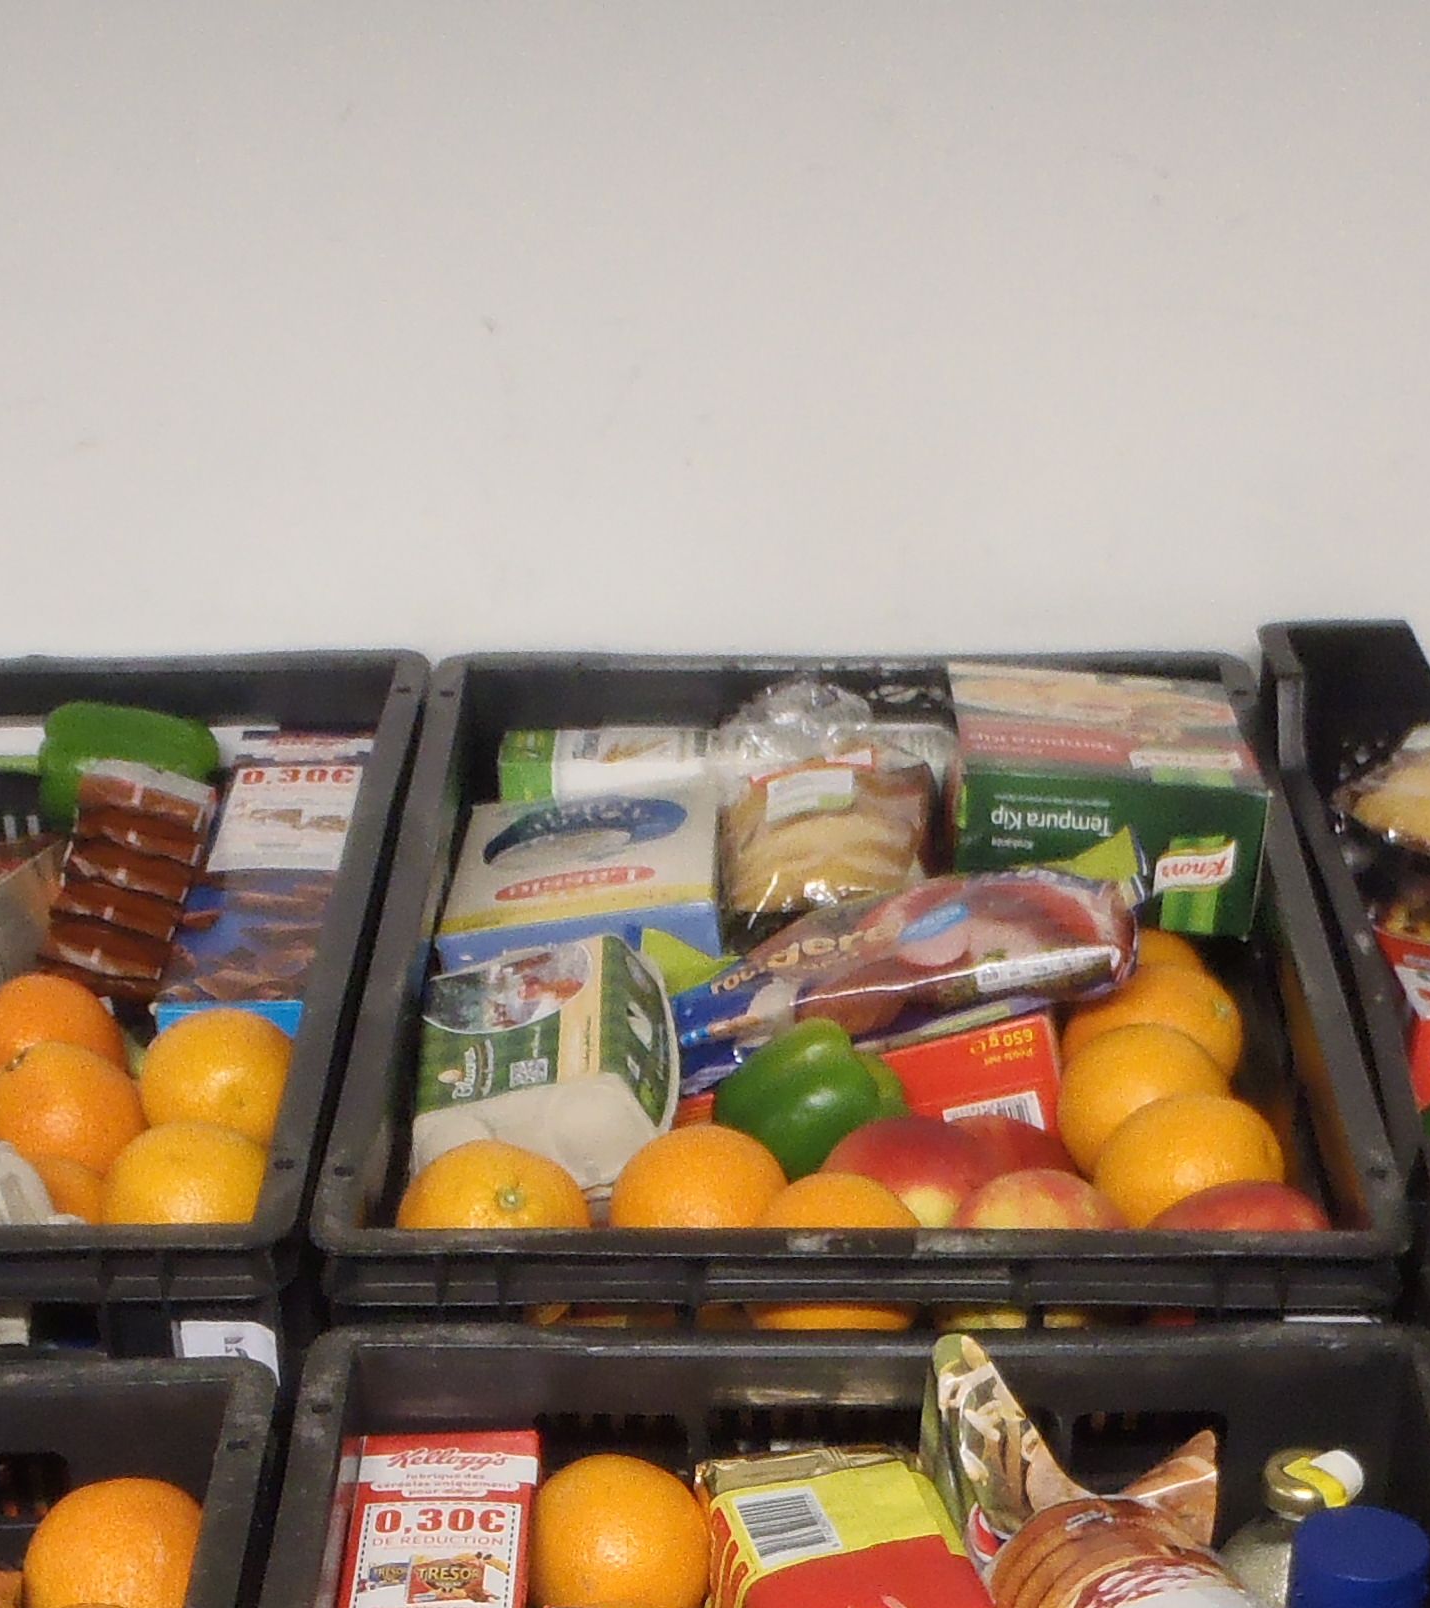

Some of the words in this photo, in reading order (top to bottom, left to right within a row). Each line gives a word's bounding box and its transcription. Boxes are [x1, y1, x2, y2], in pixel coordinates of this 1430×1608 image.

[991, 803, 1023, 830] Kip
[1027, 807, 1111, 838] Tempura
[1161, 855, 1229, 879] Knorr
[1002, 1030, 1034, 1048] 650
[387, 1447, 509, 1472] Kellogg's
[374, 1507, 507, 1535] 0,30€
[372, 1537, 397, 1547] DE
